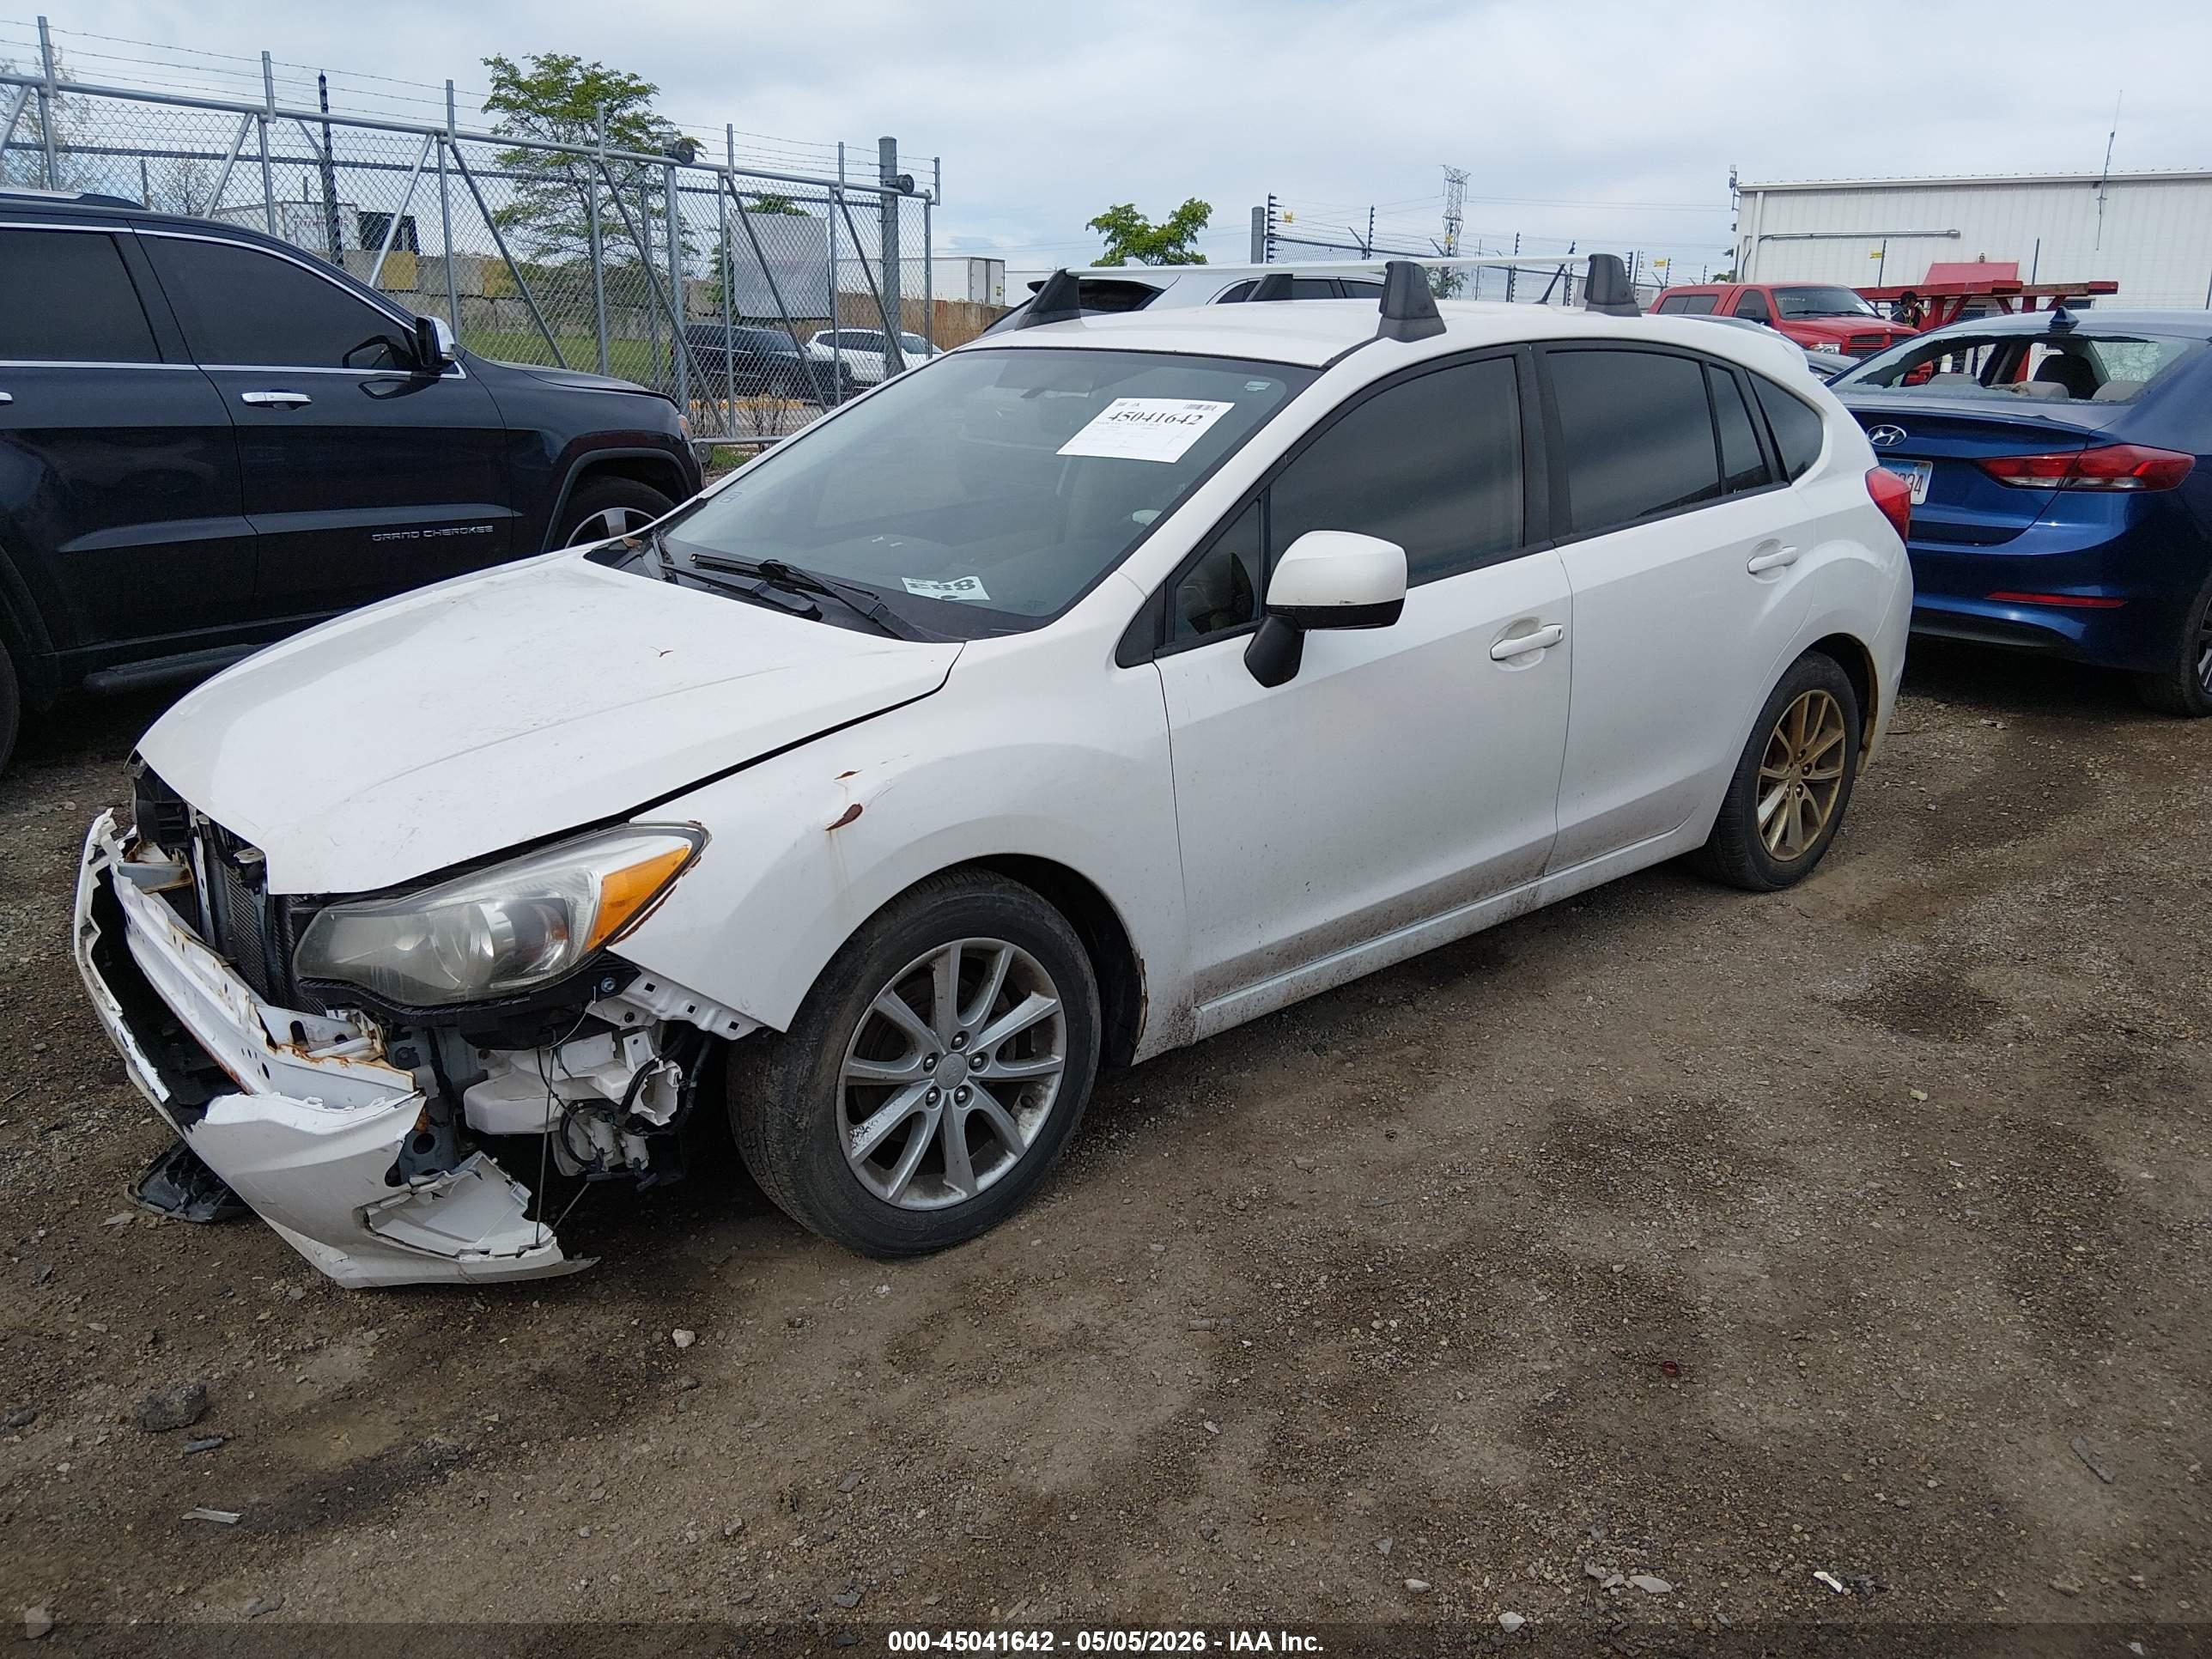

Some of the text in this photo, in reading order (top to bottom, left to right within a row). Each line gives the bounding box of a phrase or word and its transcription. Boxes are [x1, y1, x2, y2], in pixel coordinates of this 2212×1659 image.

[1108, 410, 1204, 425] 45041642
[371, 525, 495, 542] GRAND CHEROKEE
